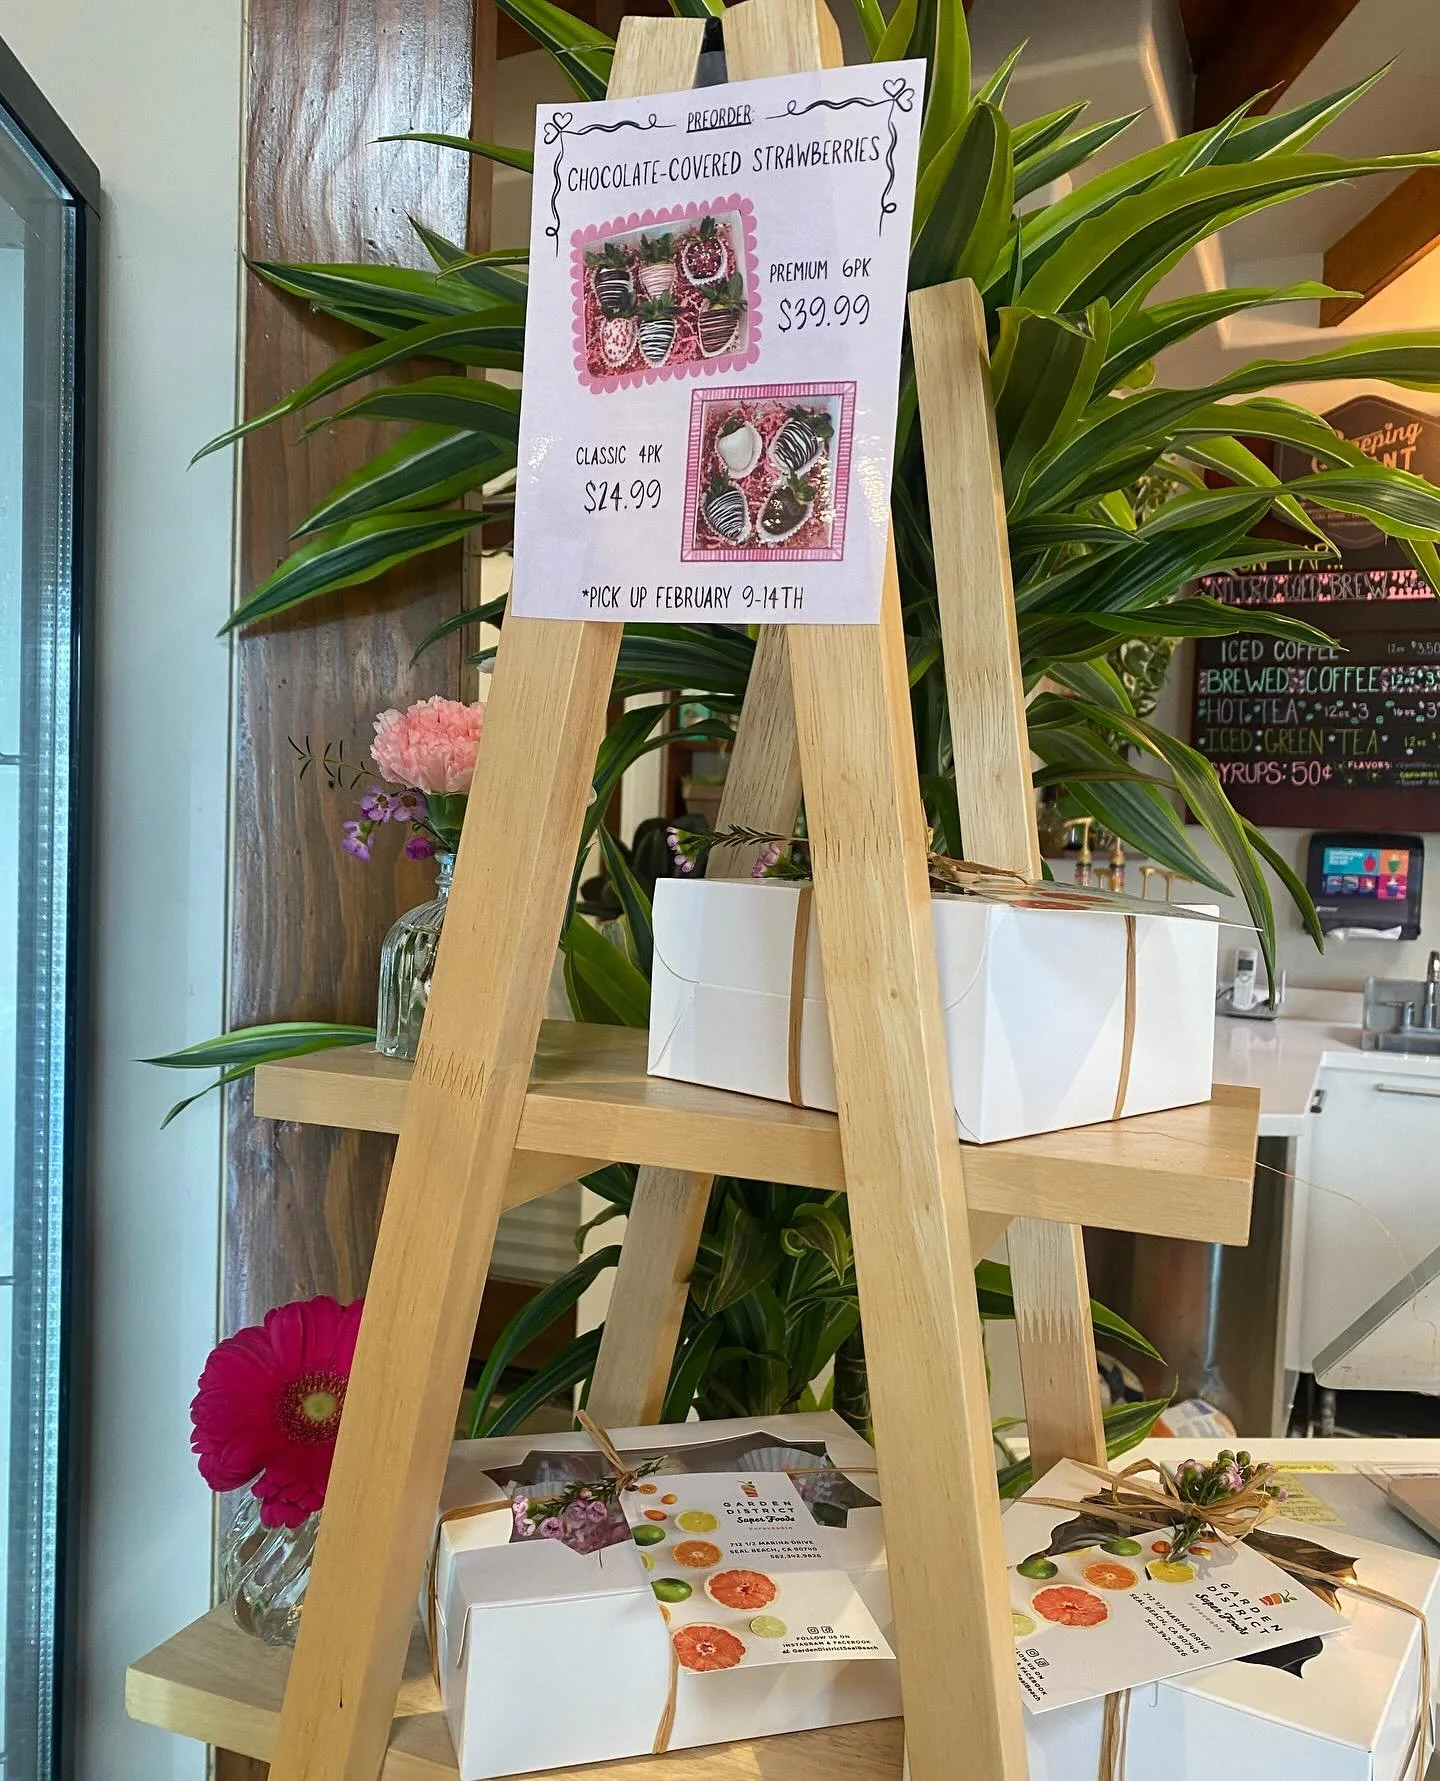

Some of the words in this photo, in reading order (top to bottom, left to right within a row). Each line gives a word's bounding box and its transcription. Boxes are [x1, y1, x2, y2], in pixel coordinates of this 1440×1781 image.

[686, 104, 755, 132] PREORDER:
[567, 151, 742, 192] CHOCOLATE-COVERED
[752, 136, 881, 172] STRAWBERRIES
[769, 260, 828, 283] PREMIUM
[842, 258, 871, 278] 6PK
[778, 294, 871, 333] $39.99
[576, 445, 626, 466] CLASSIC
[639, 444, 663, 464] 4PK
[584, 479, 662, 514] $24.99
[630, 587, 648, 608] UP
[656, 586, 731, 609] FEBRUARY
[741, 586, 804, 609] 9-14TH
[1330, 571, 1388, 599] BREW
[1221, 639, 1264, 663] ICED
[1207, 667, 1289, 694] BREWED
[1306, 666, 1381, 694] COFFEE
[1207, 698, 1248, 724] HOT
[1255, 698, 1299, 724] TEA
[1205, 728, 1253, 753] ICED
[1264, 728, 1323, 755] GREEN
[1335, 728, 1378, 756] TEA
[736, 1516, 765, 1524] Super
[765, 1515, 795, 1523] Foods
[1195, 1593, 1222, 1614] Super
[1218, 1612, 1249, 1636] Foods
[1206, 1585, 1270, 1634] DISTRICT
[1220, 1582, 1284, 1632] GARDEN
[1128, 1593, 1146, 1607] SEAL
[1145, 1606, 1167, 1627] BEACH,
[1168, 1626, 1180, 1635] CA
[1177, 1634, 1199, 1654] 90740
[1143, 1592, 1155, 1602] 712
[1164, 1610, 1190, 1633] MARINA
[1189, 1632, 1212, 1651] DRIVE
